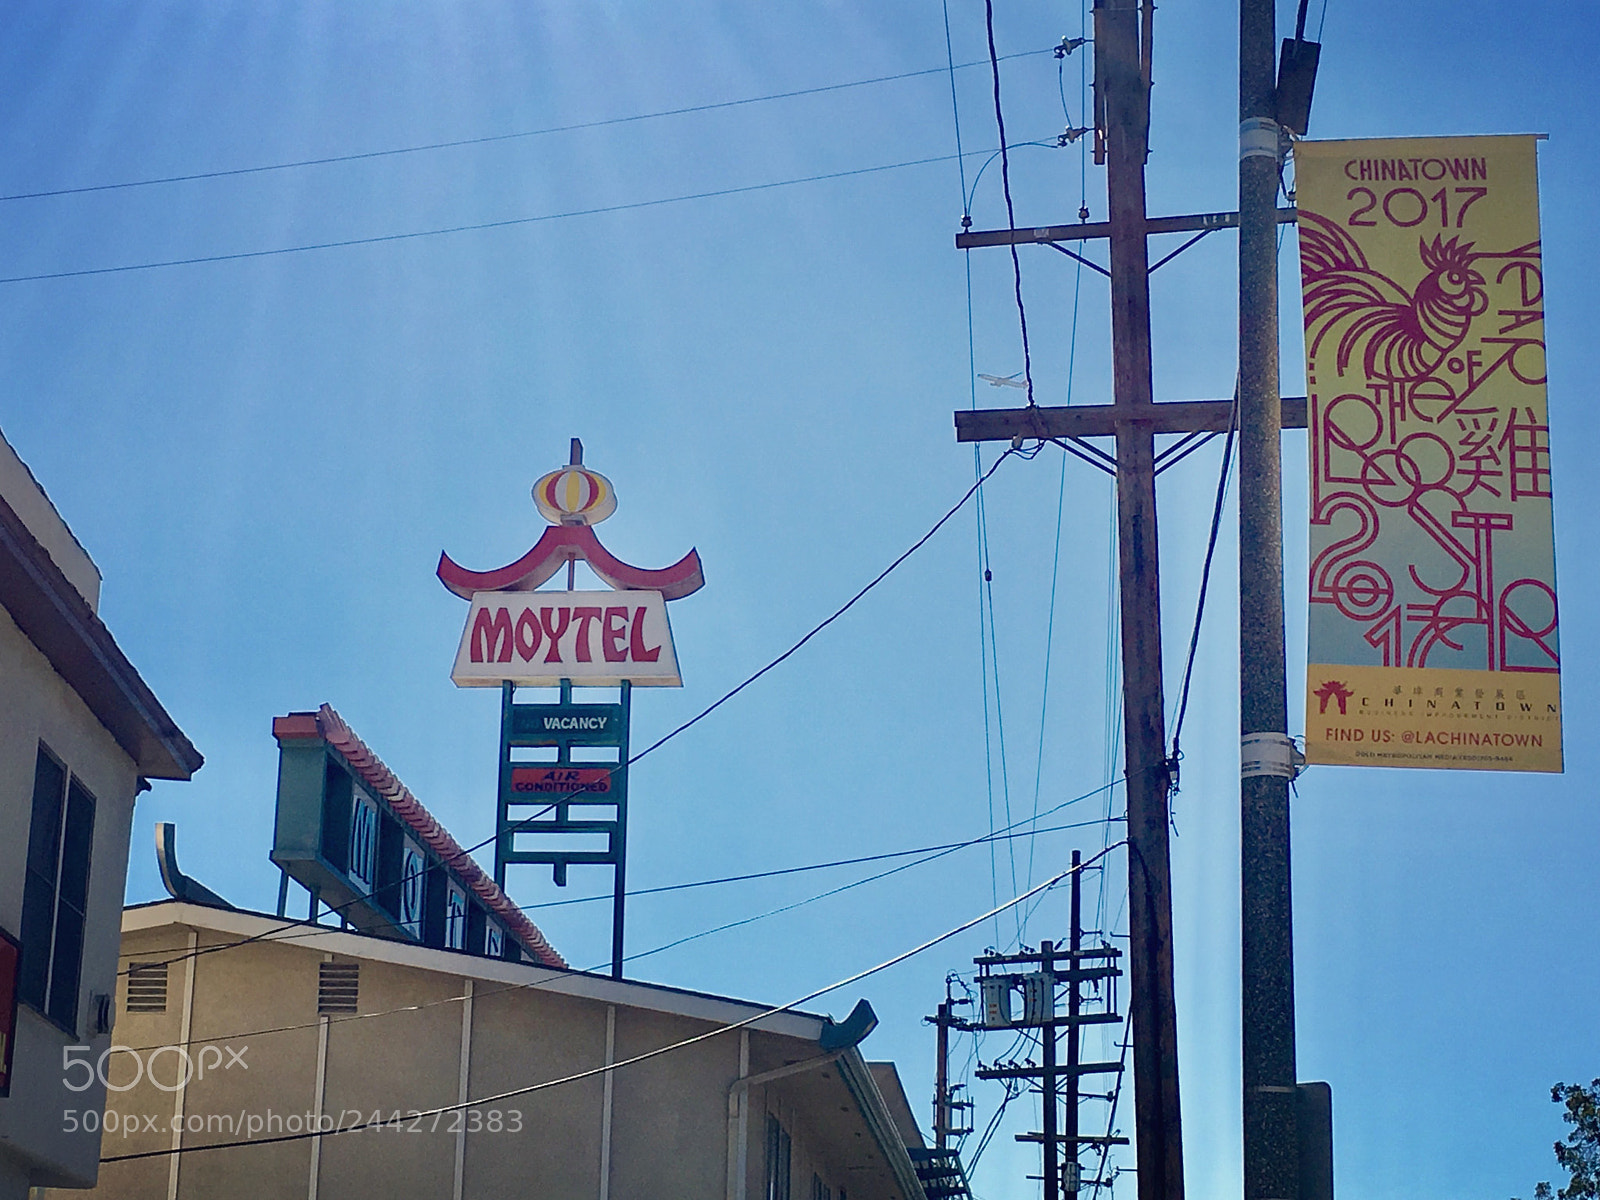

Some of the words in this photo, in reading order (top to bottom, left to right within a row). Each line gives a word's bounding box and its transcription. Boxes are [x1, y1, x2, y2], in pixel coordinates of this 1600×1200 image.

[1344, 158, 1487, 181] CHINATOWN
[1346, 186, 1488, 228] 2017
[470, 606, 662, 663] MOYTEL
[1361, 697, 1557, 713] CHINATOWN
[543, 716, 608, 730] VACANCY
[1326, 728, 1365, 742] FIND
[1372, 730, 1395, 743] US:
[1402, 730, 1544, 747] @LACHINATOWN
[541, 770, 581, 782] AIR
[514, 781, 609, 793] CONDITIONED
